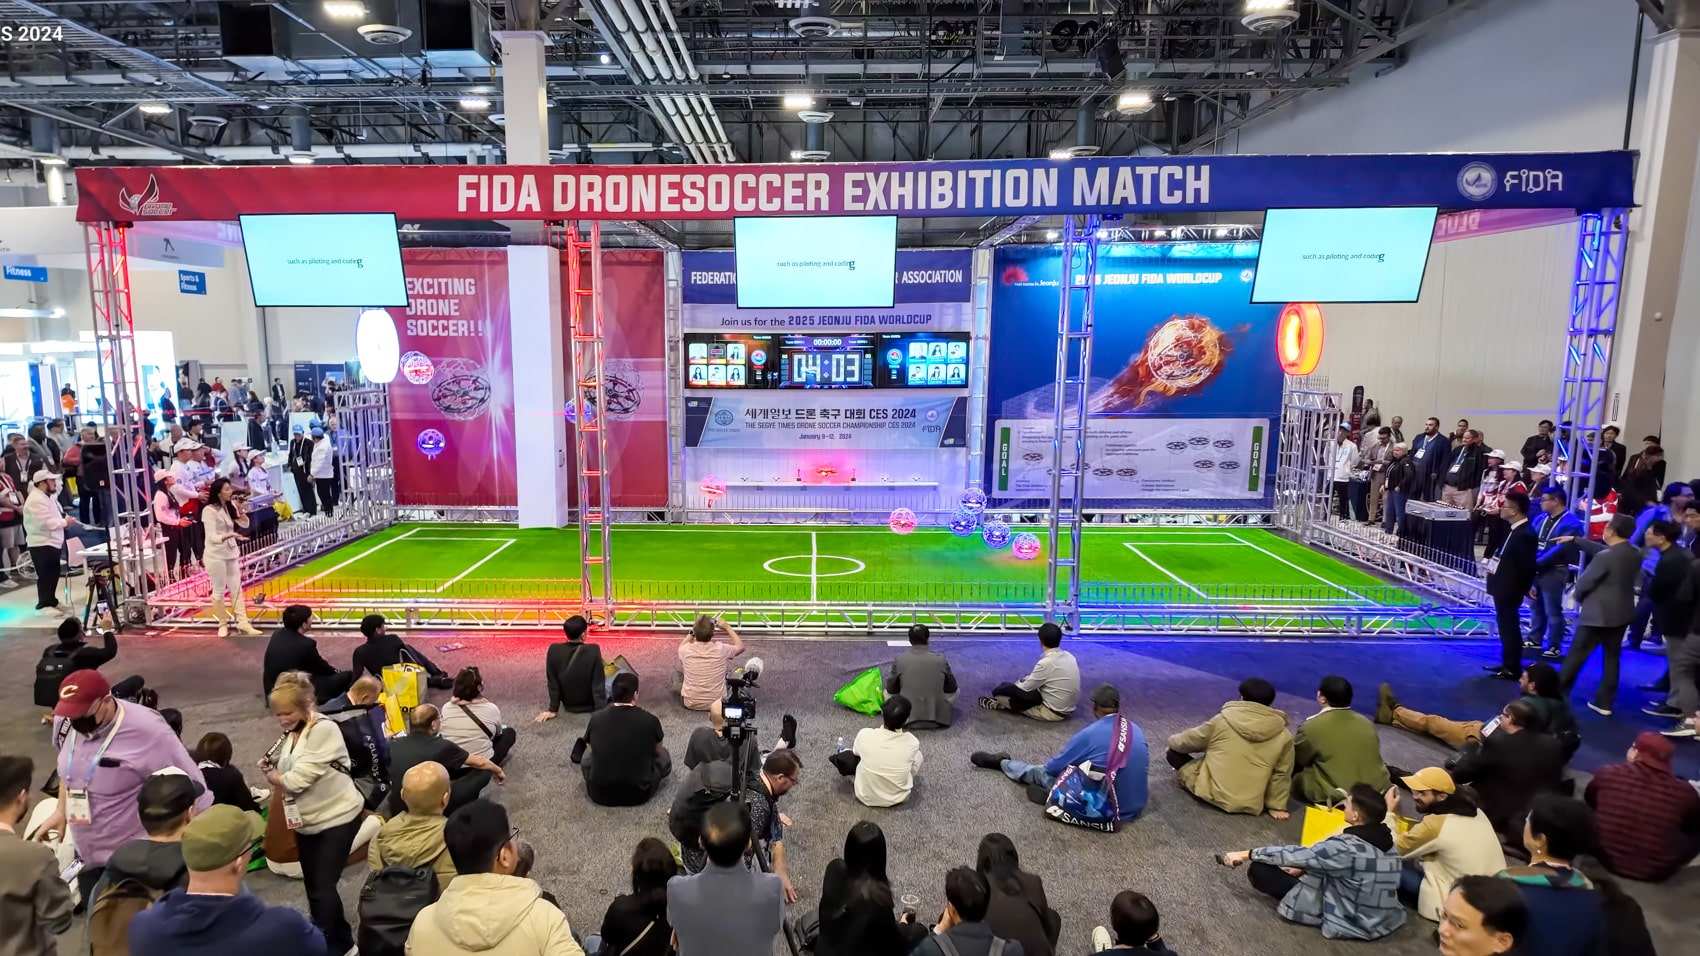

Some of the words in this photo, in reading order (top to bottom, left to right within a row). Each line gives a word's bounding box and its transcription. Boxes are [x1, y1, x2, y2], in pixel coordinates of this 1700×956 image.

[1503, 168, 1563, 194] FIDA
[458, 174, 541, 213] FIDA
[553, 172, 830, 213] DRONESOCCER
[843, 168, 1058, 211] EXHIBITION
[1073, 165, 1210, 206] MATCH
[308, 258, 331, 266] piloting
[1325, 253, 1350, 261] piloting
[6, 266, 32, 277] Fitness
[902, 270, 963, 284] ASSOCIATION
[1103, 274, 1139, 285] JEONJU
[1141, 273, 1164, 284] FIDA
[1166, 273, 1222, 284] WORLDCUP
[181, 282, 198, 291] Fitness
[405, 278, 476, 296] EXCITING
[405, 298, 460, 316] DRONE
[720, 317, 739, 326] Join
[754, 317, 768, 326] for
[770, 317, 786, 326] the
[788, 315, 815, 326] 2025
[817, 315, 852, 326] JEONJU
[855, 314, 876, 325] FIDA
[878, 314, 933, 325] WORLDCUP
[407, 319, 483, 337] SOCCER!!
[813, 338, 842, 346] 00:00:00
[793, 354, 860, 382] 04:03
[795, 408, 817, 420] 드론
[820, 408, 841, 420] 축구
[845, 408, 866, 420] 대회
[869, 408, 889, 420] CES
[892, 408, 917, 420] 2024
[745, 421, 757, 429] THE
[758, 421, 776, 429] SEGYE
[778, 421, 796, 429] TIMES
[797, 421, 817, 429] DRONE
[818, 421, 842, 429] SOCCER
[843, 421, 887, 429] CHAMPIONSHIP
[888, 421, 900, 429] CES
[901, 421, 917, 429] 2024
[1252, 443, 1260, 475] GOAL
[1119, 717, 1128, 743] SANSUI
[1062, 813, 1115, 832] SANSUI
